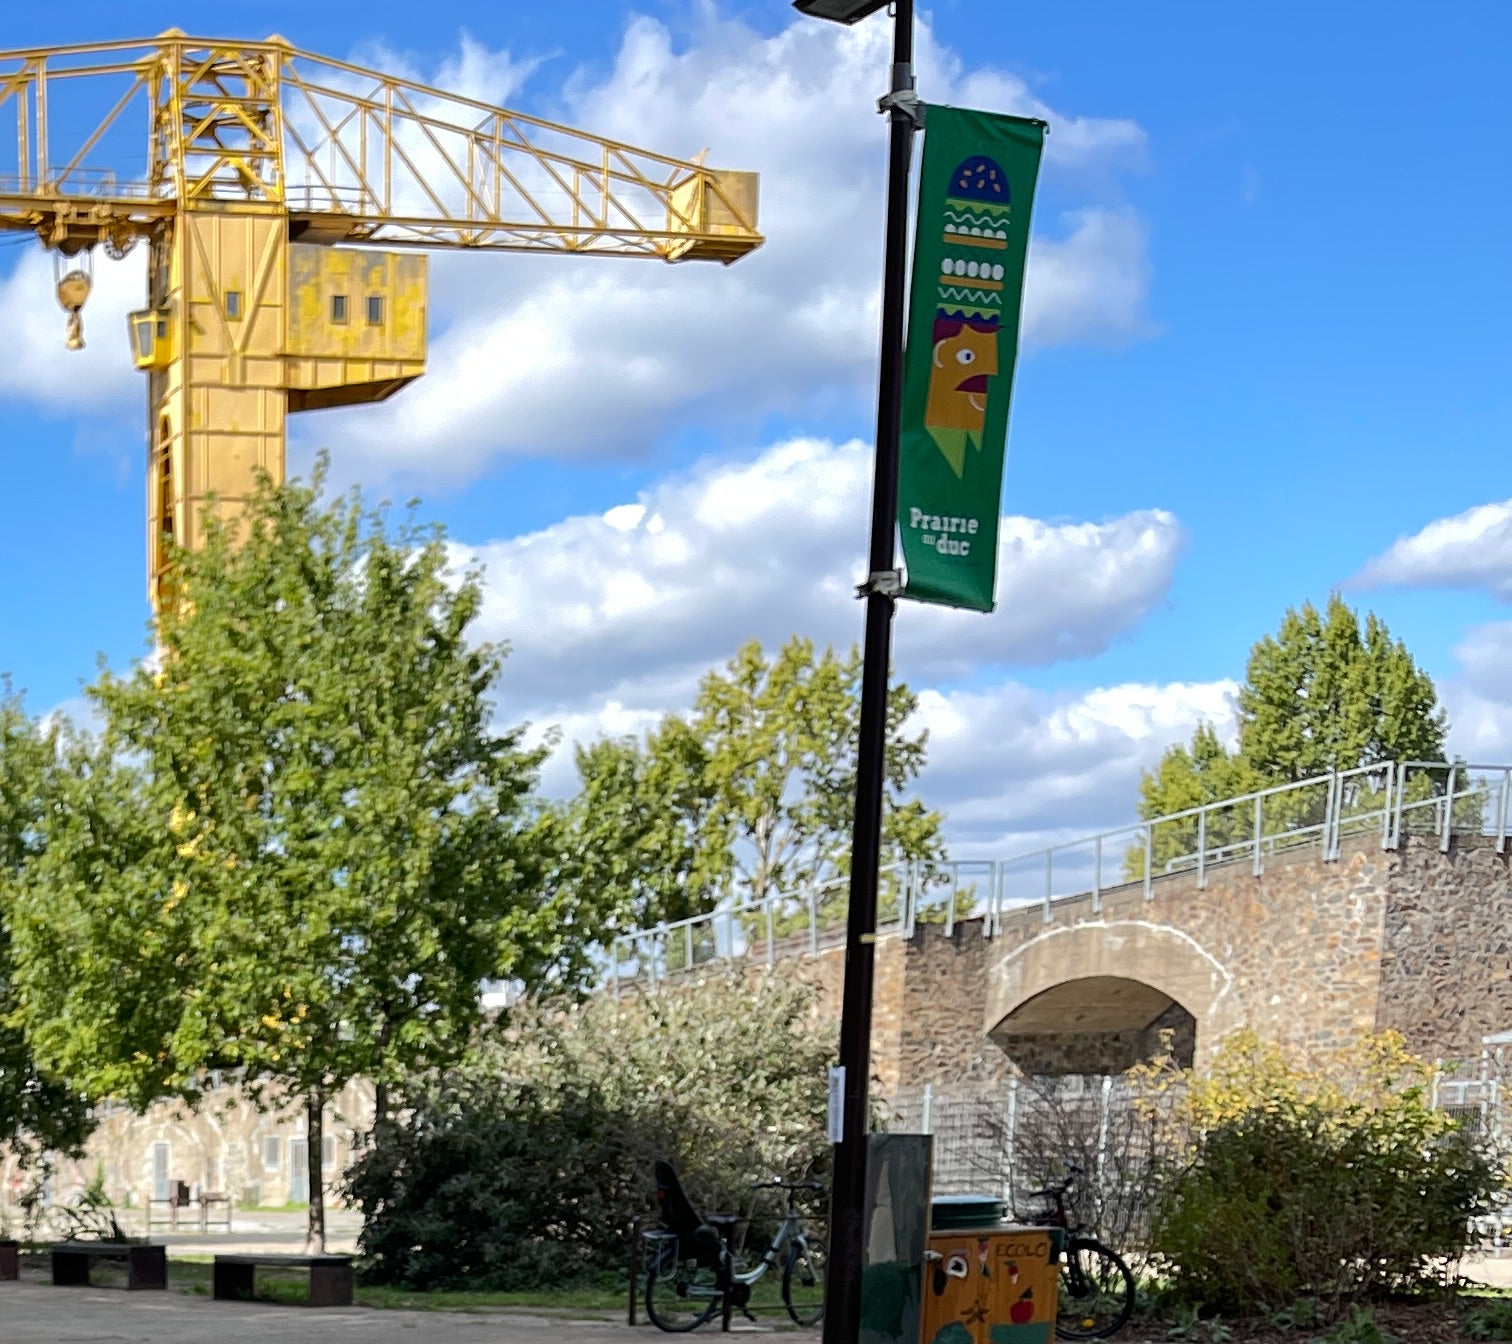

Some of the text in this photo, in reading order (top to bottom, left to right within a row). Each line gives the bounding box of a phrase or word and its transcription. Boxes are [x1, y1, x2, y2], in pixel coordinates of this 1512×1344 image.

[909, 507, 979, 534] Prairie
[936, 533, 970, 556] duc
[996, 1242, 1047, 1258] ECOLO
